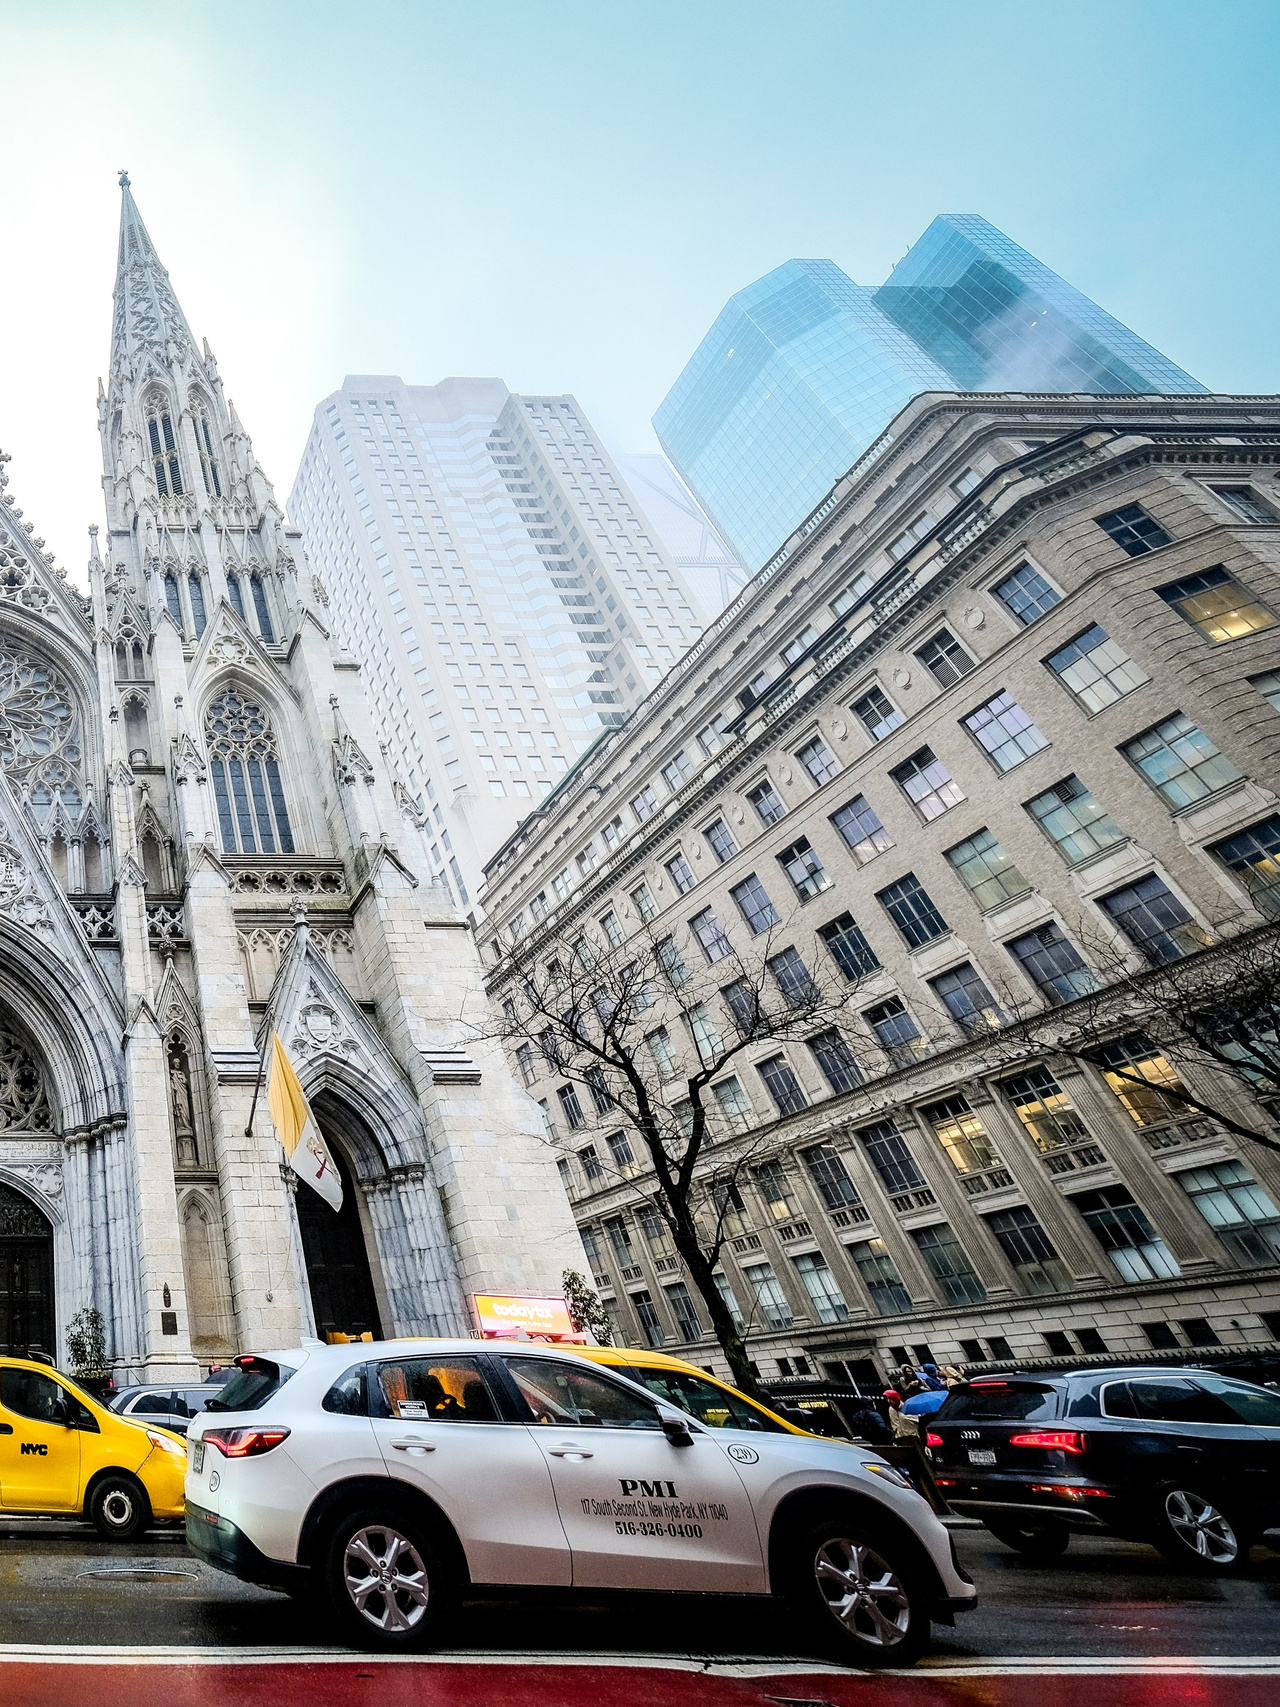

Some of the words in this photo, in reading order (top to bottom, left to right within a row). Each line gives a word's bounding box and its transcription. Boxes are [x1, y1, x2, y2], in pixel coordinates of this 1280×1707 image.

[20, 1443, 48, 1456] NYC
[731, 1447, 753, 1460] 239
[618, 1478, 679, 1498] PMI
[580, 1498, 590, 1515] 117
[591, 1498, 613, 1516] South
[611, 1499, 639, 1517] Second
[637, 1500, 648, 1517] St.
[647, 1501, 663, 1518] New
[662, 1501, 681, 1521] Hyde
[680, 1502, 699, 1520] Park,
[697, 1503, 709, 1519] NY
[708, 1503, 729, 1520] 11040
[615, 1520, 703, 1538] 516-326-0400
